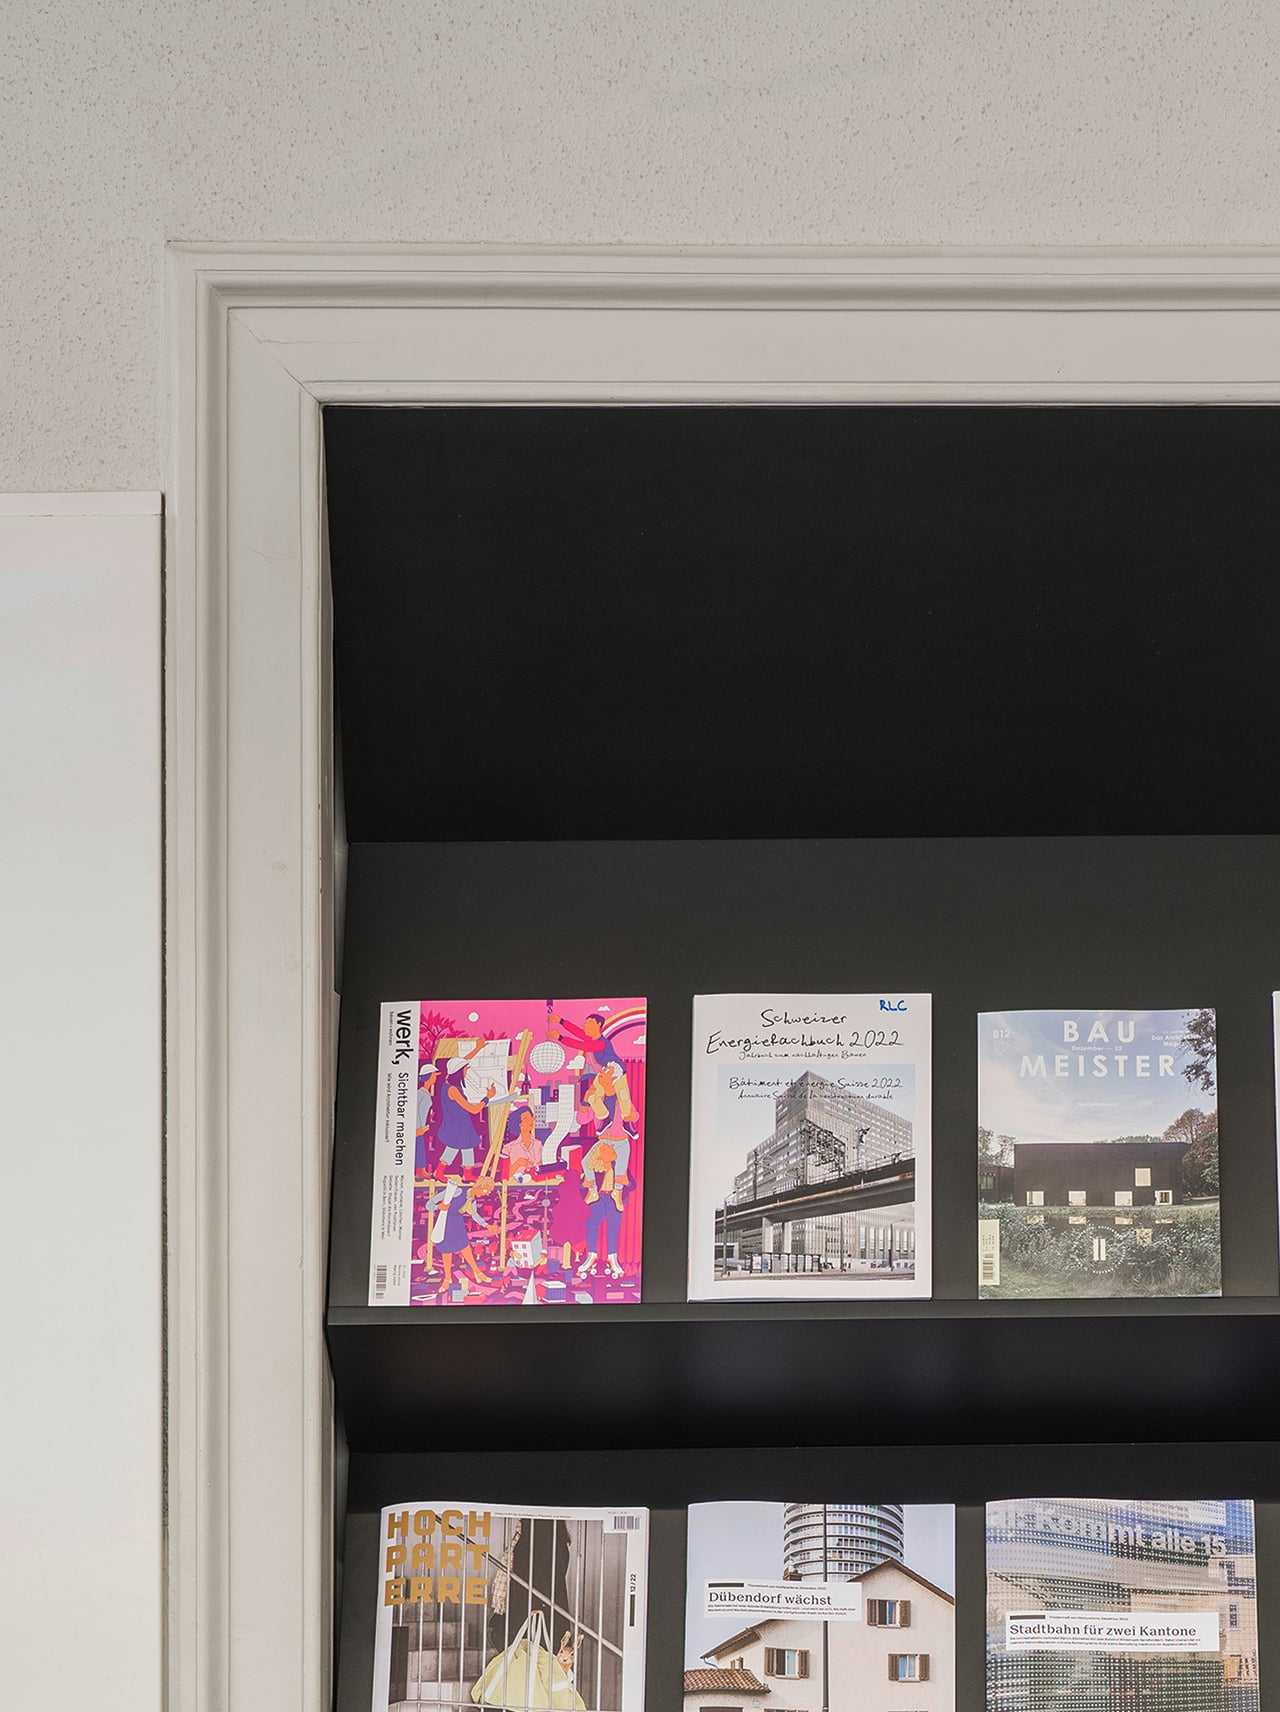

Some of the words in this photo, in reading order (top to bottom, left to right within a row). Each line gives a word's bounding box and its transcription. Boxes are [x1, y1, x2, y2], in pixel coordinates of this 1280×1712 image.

[880, 1000, 907, 1012] RLC
[761, 1009, 848, 1028] Schweizer
[392, 1010, 414, 1065] werk,
[706, 1030, 844, 1054] Energiefachbuch
[850, 1030, 904, 1048] 2022
[992, 1030, 1011, 1039] B12
[1064, 1020, 1136, 1043] BAU
[842, 1051, 867, 1060] Bauen
[1019, 1055, 1174, 1078] MEISTER
[396, 1072, 408, 1118] Sichtbar
[773, 1091, 796, 1100] Suisse
[866, 1091, 894, 1100] durable
[785, 1078, 794, 1088] et
[838, 1078, 869, 1090] Suisse
[871, 1078, 902, 1089] 2022
[394, 1122, 408, 1166] machen
[388, 1510, 491, 1539] HOCH
[1150, 1524, 1196, 1551] alle
[1203, 1534, 1228, 1556] 15
[386, 1542, 490, 1573] PART
[384, 1576, 488, 1607] ERRE
[709, 1592, 782, 1604] Dübendorf
[784, 1594, 832, 1606] wächst
[1010, 1624, 1081, 1636] Stadtbahn
[1084, 1624, 1104, 1636] für
[1106, 1626, 1136, 1636] zwei
[1140, 1626, 1196, 1636] Kantone
